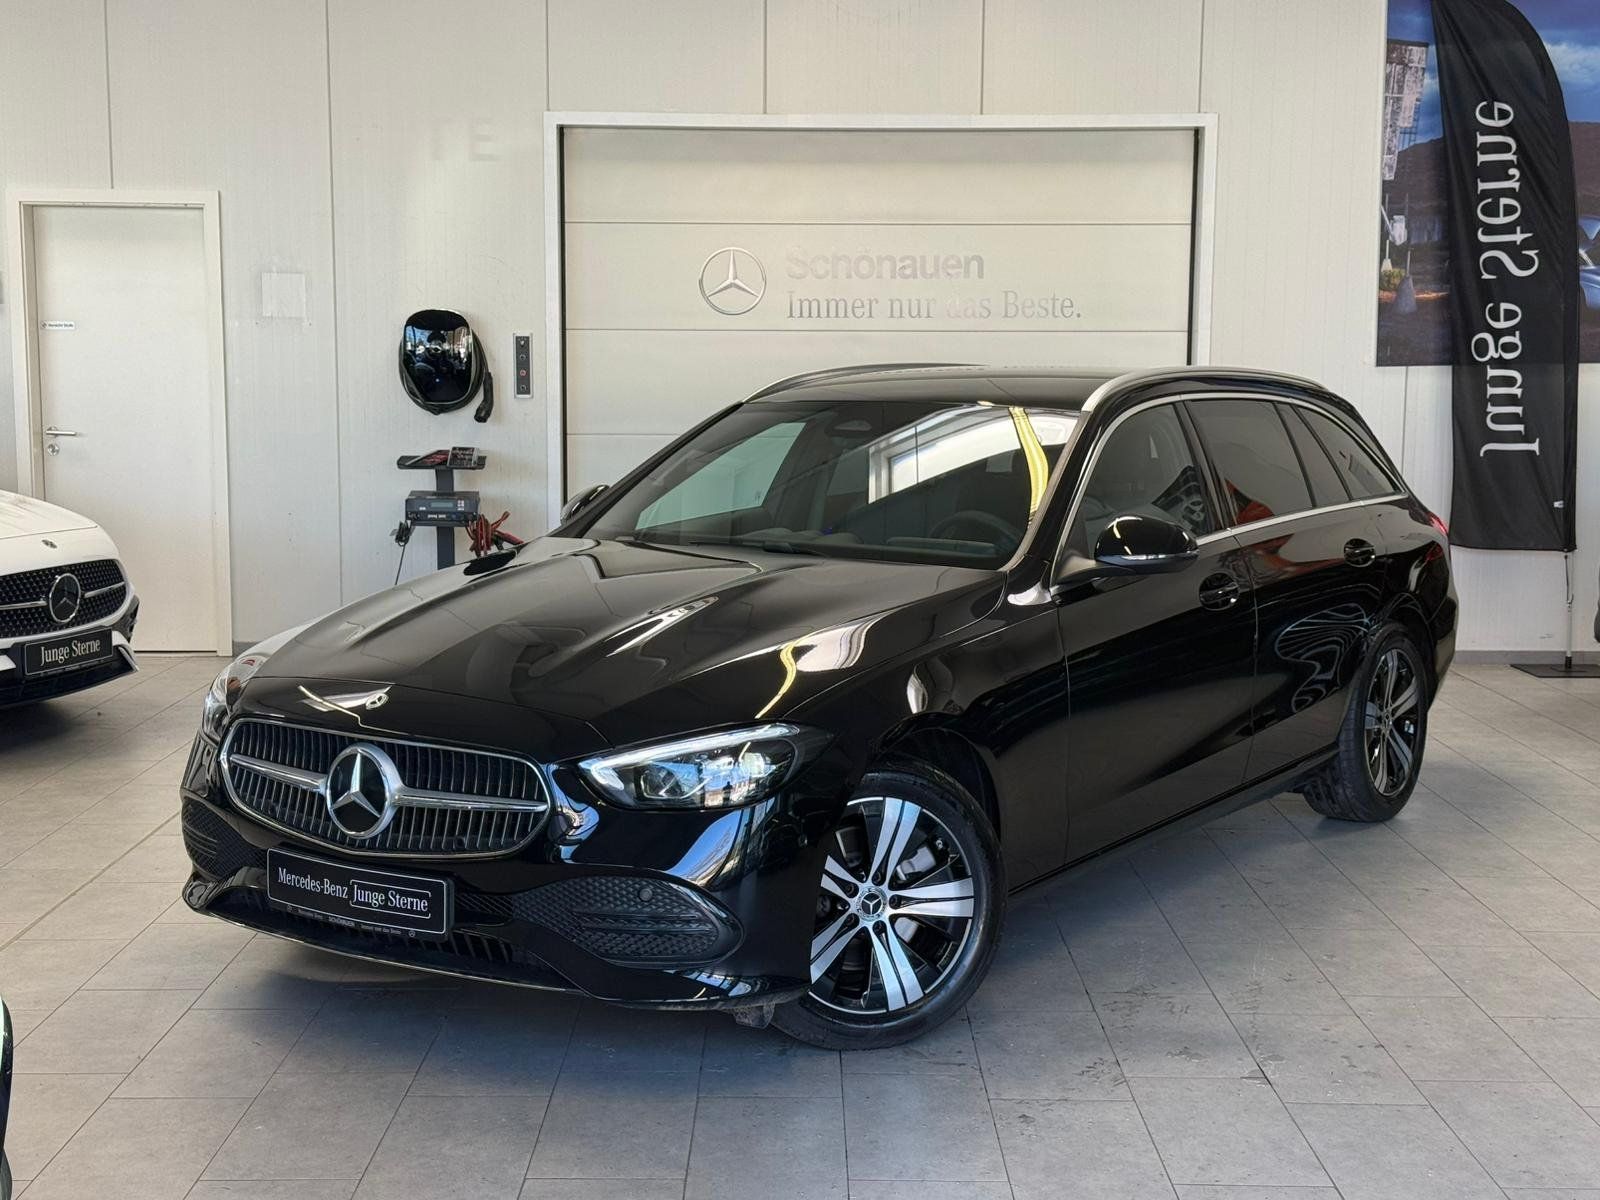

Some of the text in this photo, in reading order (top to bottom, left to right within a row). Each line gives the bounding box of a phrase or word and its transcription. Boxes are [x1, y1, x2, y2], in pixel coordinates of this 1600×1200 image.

[786, 246, 985, 280] Schönauen
[786, 289, 1082, 319] Immer nur das Beste.
[40, 639, 101, 667] Junge Sterne
[277, 866, 429, 912] Mercedes-Benz Junge Sterne
